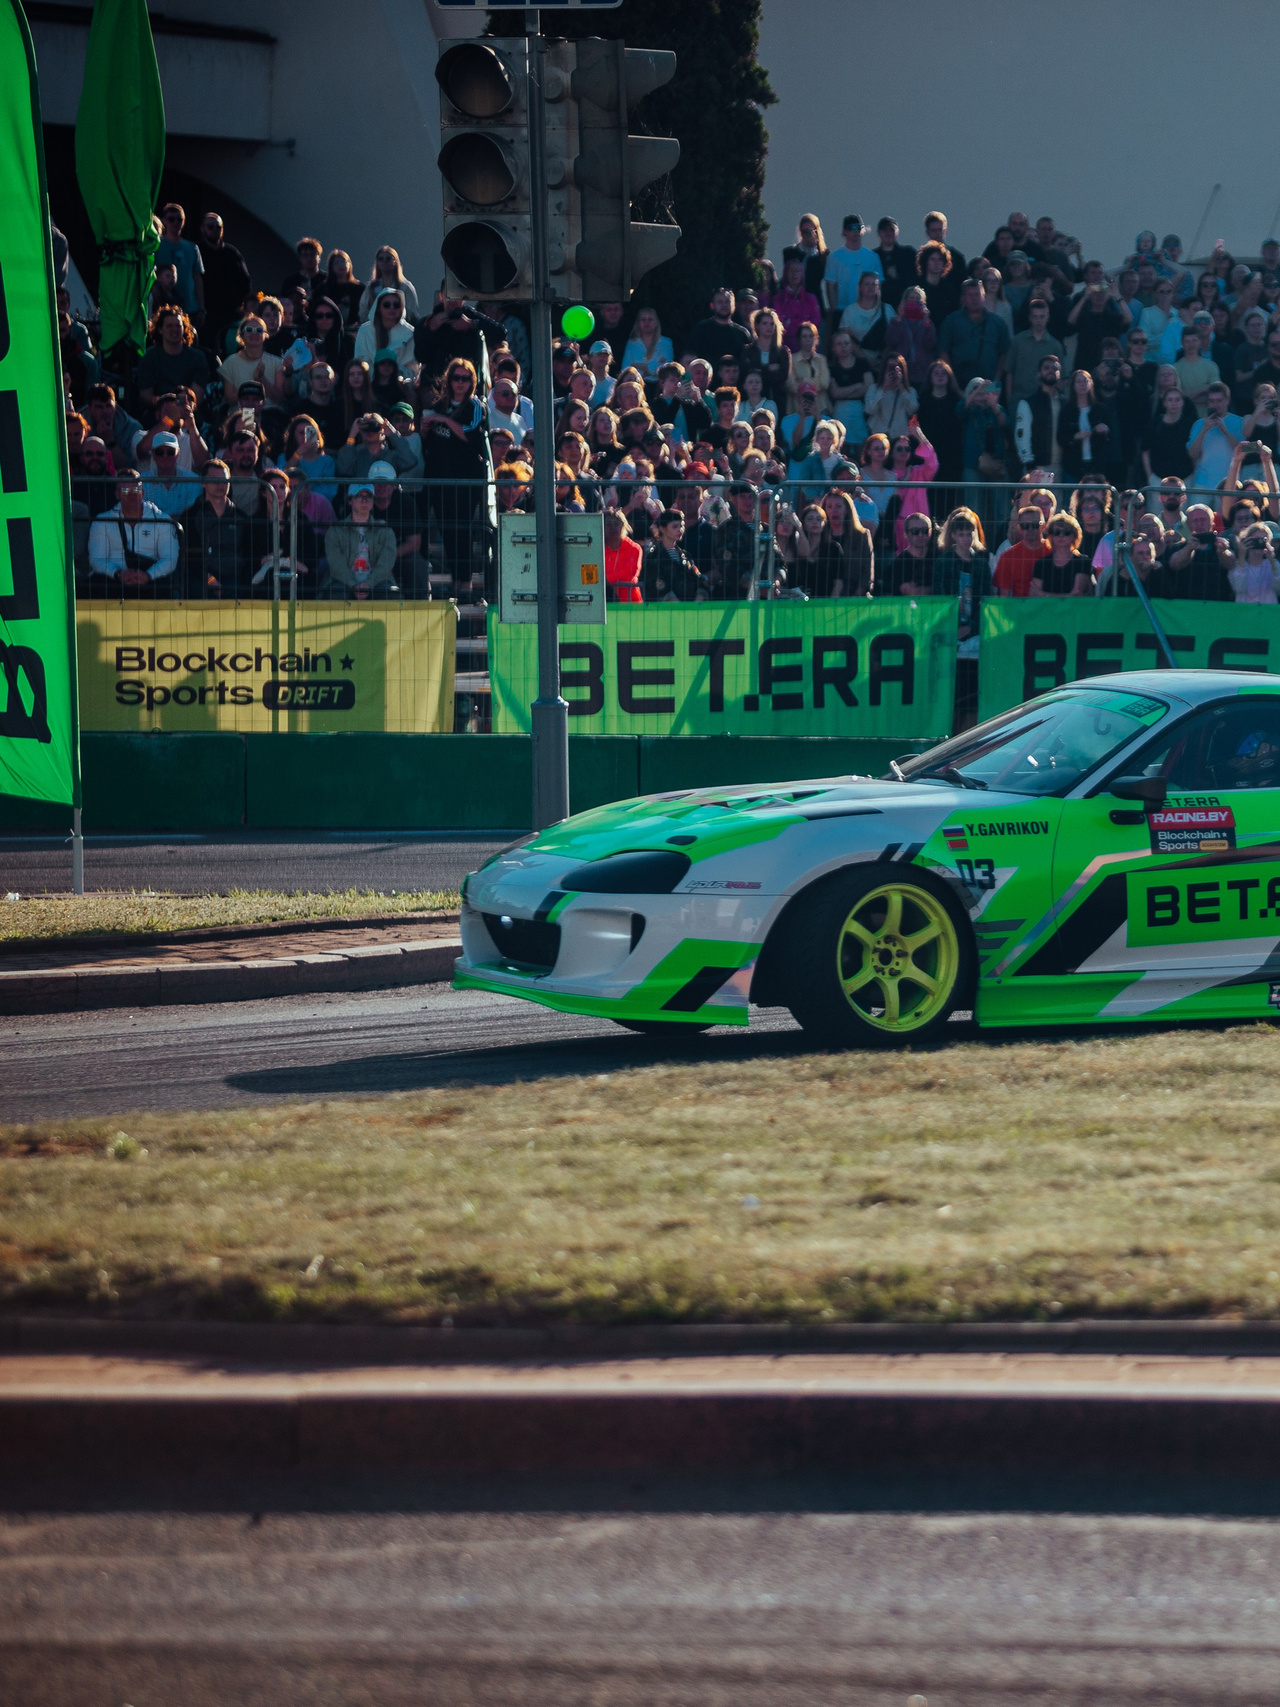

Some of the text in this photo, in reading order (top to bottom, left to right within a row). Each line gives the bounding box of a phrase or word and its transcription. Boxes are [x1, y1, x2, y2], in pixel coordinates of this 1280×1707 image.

[115, 646, 332, 672] Blockchain
[558, 632, 915, 716] BET.ERA
[115, 679, 344, 711] Sports DRIFT
[1162, 796, 1220, 807] ET.ERA
[1152, 811, 1228, 823] RACING.BY
[966, 821, 1049, 836] Y.GAVRIKOV
[1158, 830, 1220, 840] Blockchain
[1159, 841, 1198, 851] Sports
